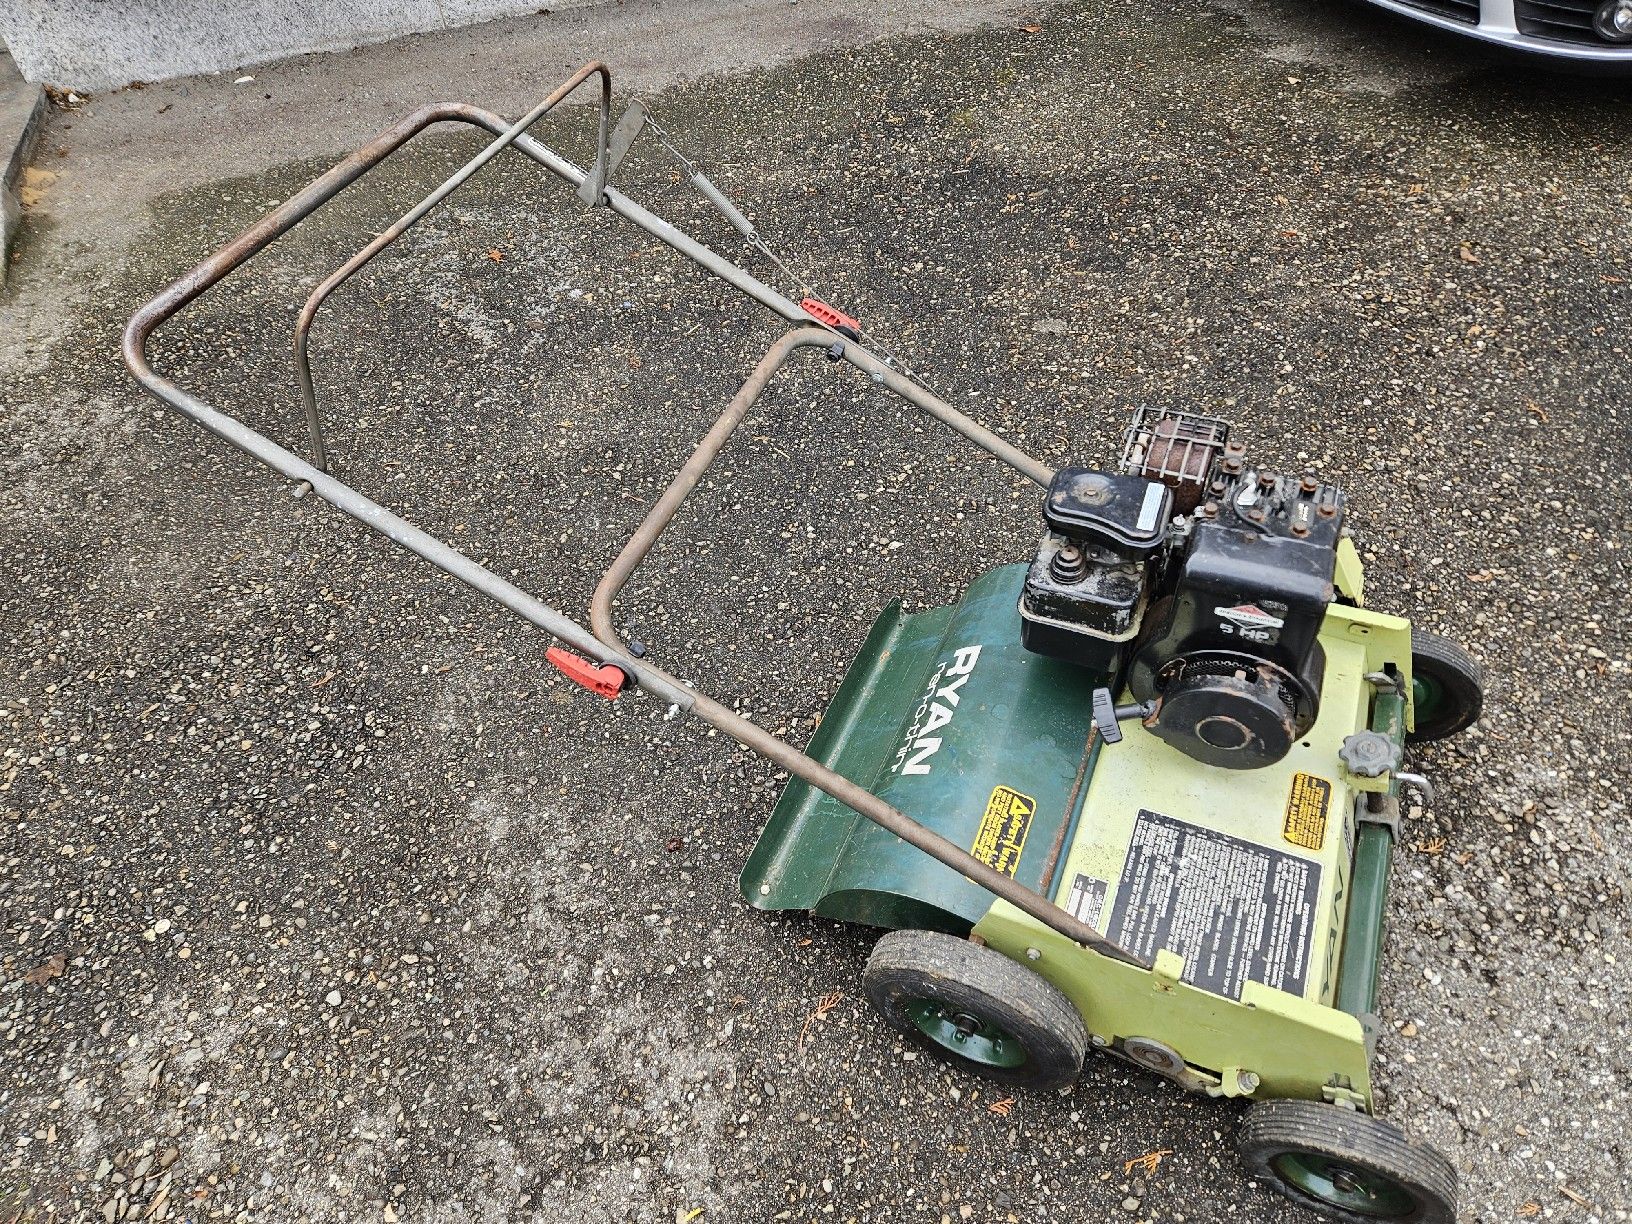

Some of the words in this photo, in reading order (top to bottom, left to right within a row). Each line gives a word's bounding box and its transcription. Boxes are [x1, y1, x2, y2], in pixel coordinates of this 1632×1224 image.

[1220, 623, 1234, 634] 5
[1239, 628, 1270, 640] HP
[901, 645, 982, 775] RYAN
